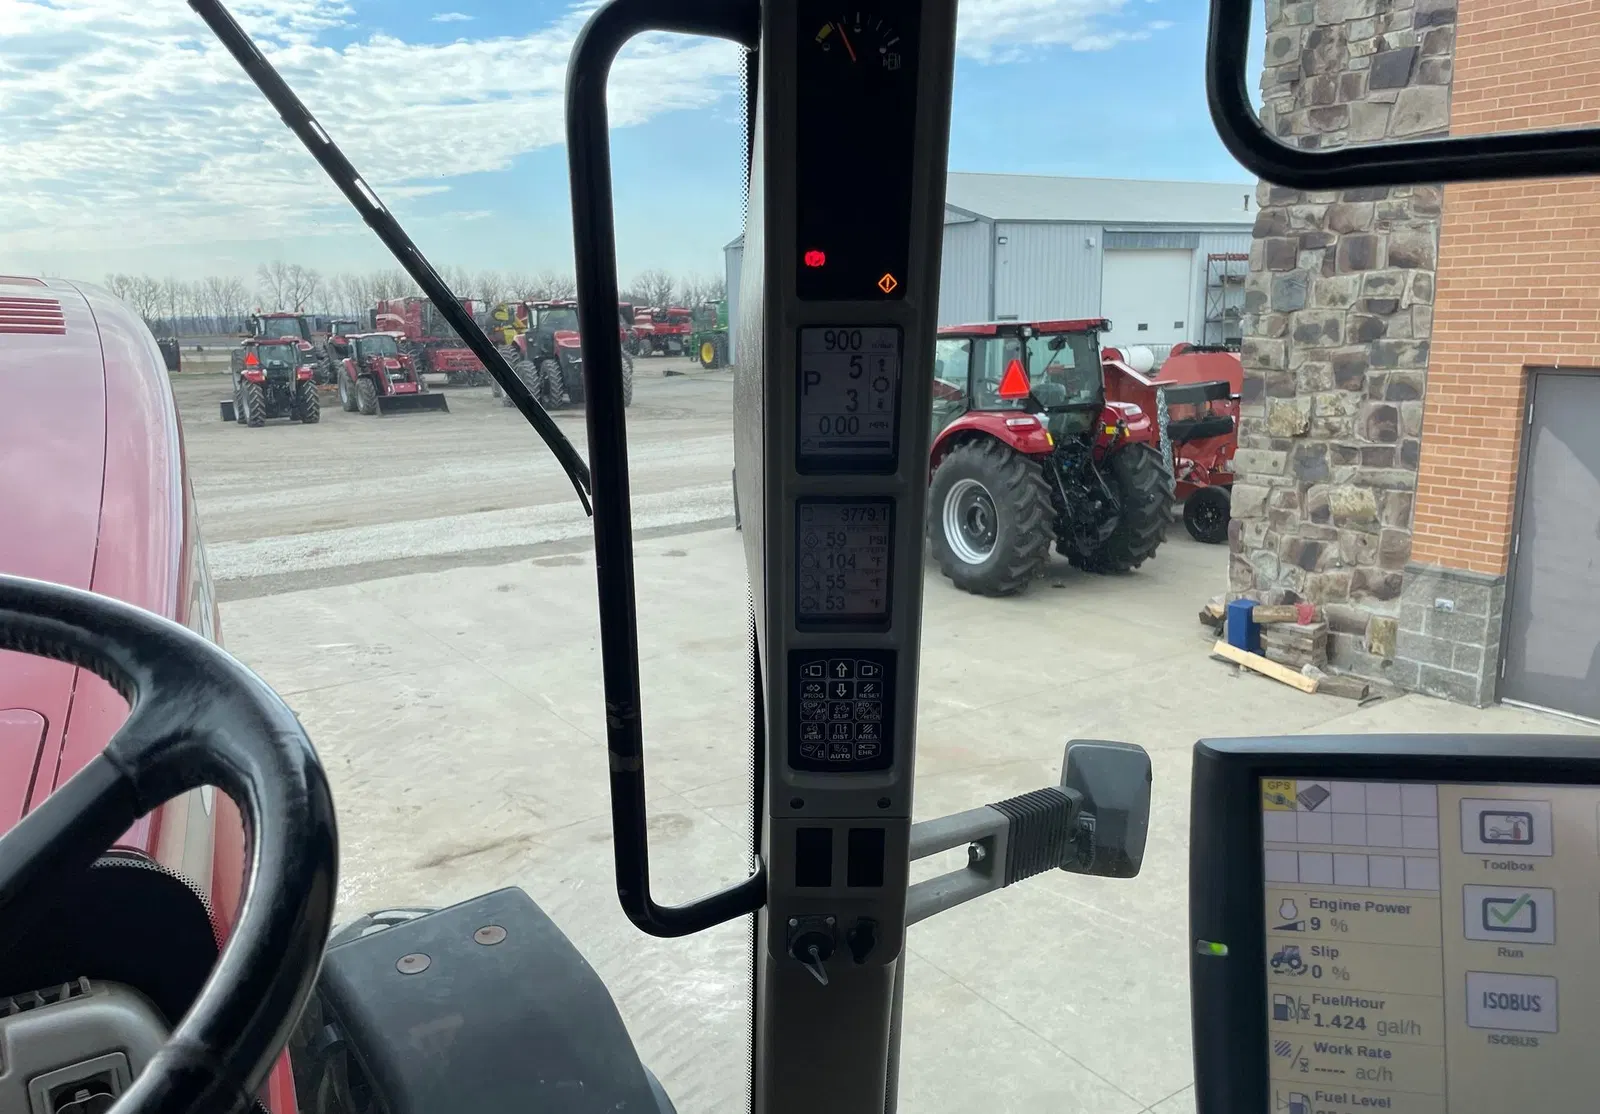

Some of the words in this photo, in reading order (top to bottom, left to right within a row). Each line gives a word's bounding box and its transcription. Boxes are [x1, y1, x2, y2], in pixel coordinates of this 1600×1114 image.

[824, 329, 863, 351] 900
[849, 355, 863, 379] 5
[804, 370, 821, 396] P
[845, 388, 859, 413] 3
[819, 415, 860, 436] 0.00
[841, 507, 887, 521] 3779.1
[826, 531, 847, 547] 59
[827, 553, 856, 569] 104
[826, 574, 847, 589] 55
[826, 595, 846, 610] 53
[1267, 781, 1291, 791] GPS
[1481, 859, 1535, 872] Toolbox
[1309, 898, 1361, 915] Engine
[1365, 901, 1412, 915] Power
[1310, 917, 1321, 931] 9
[1330, 918, 1349, 933] %
[1310, 946, 1340, 960] Slip
[1497, 947, 1524, 959] Run
[1311, 964, 1322, 979] 0
[1332, 966, 1350, 981] %
[1312, 993, 1386, 1011] Fuel/Hour
[1482, 991, 1542, 1013] ISOBUS
[1313, 1014, 1367, 1031] 1.424
[1376, 1018, 1422, 1037] gal/h
[1487, 1033, 1539, 1048] ISOBUS
[1314, 1041, 1355, 1057] Work
[1358, 1045, 1393, 1060] Rate
[1355, 1065, 1394, 1083] ac/h
[1315, 1090, 1350, 1105] Fuel
[1351, 1092, 1393, 1110] Level
